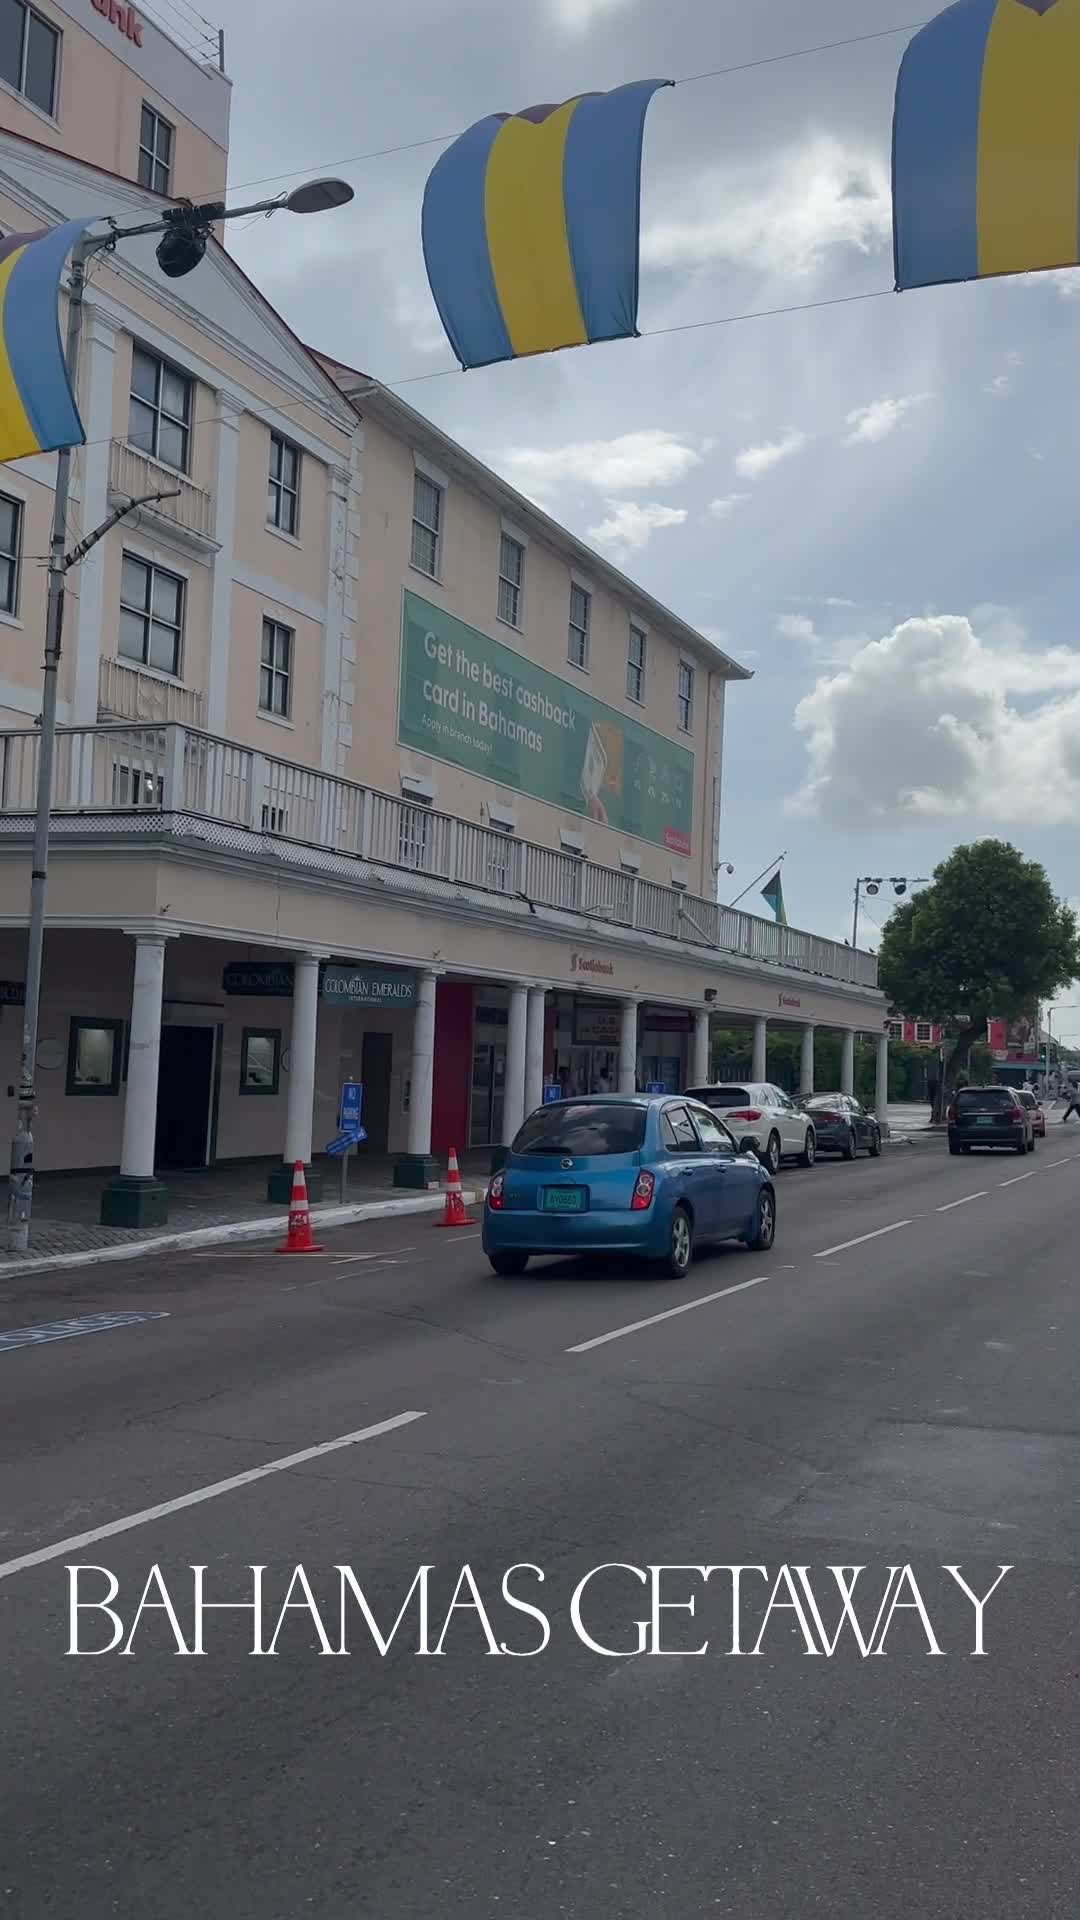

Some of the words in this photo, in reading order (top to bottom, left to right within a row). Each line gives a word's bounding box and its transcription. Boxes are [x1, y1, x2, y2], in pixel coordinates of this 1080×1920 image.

[423, 680, 459, 713] card
[462, 692, 475, 721] in
[478, 701, 543, 752] Bahamas
[424, 632, 453, 667] Get
[456, 649, 480, 682] the
[482, 662, 515, 698] best
[516, 685, 576, 730] cashback
[324, 978, 368, 995] COLOMBIAN
[372, 981, 412, 999] EMERALDS
